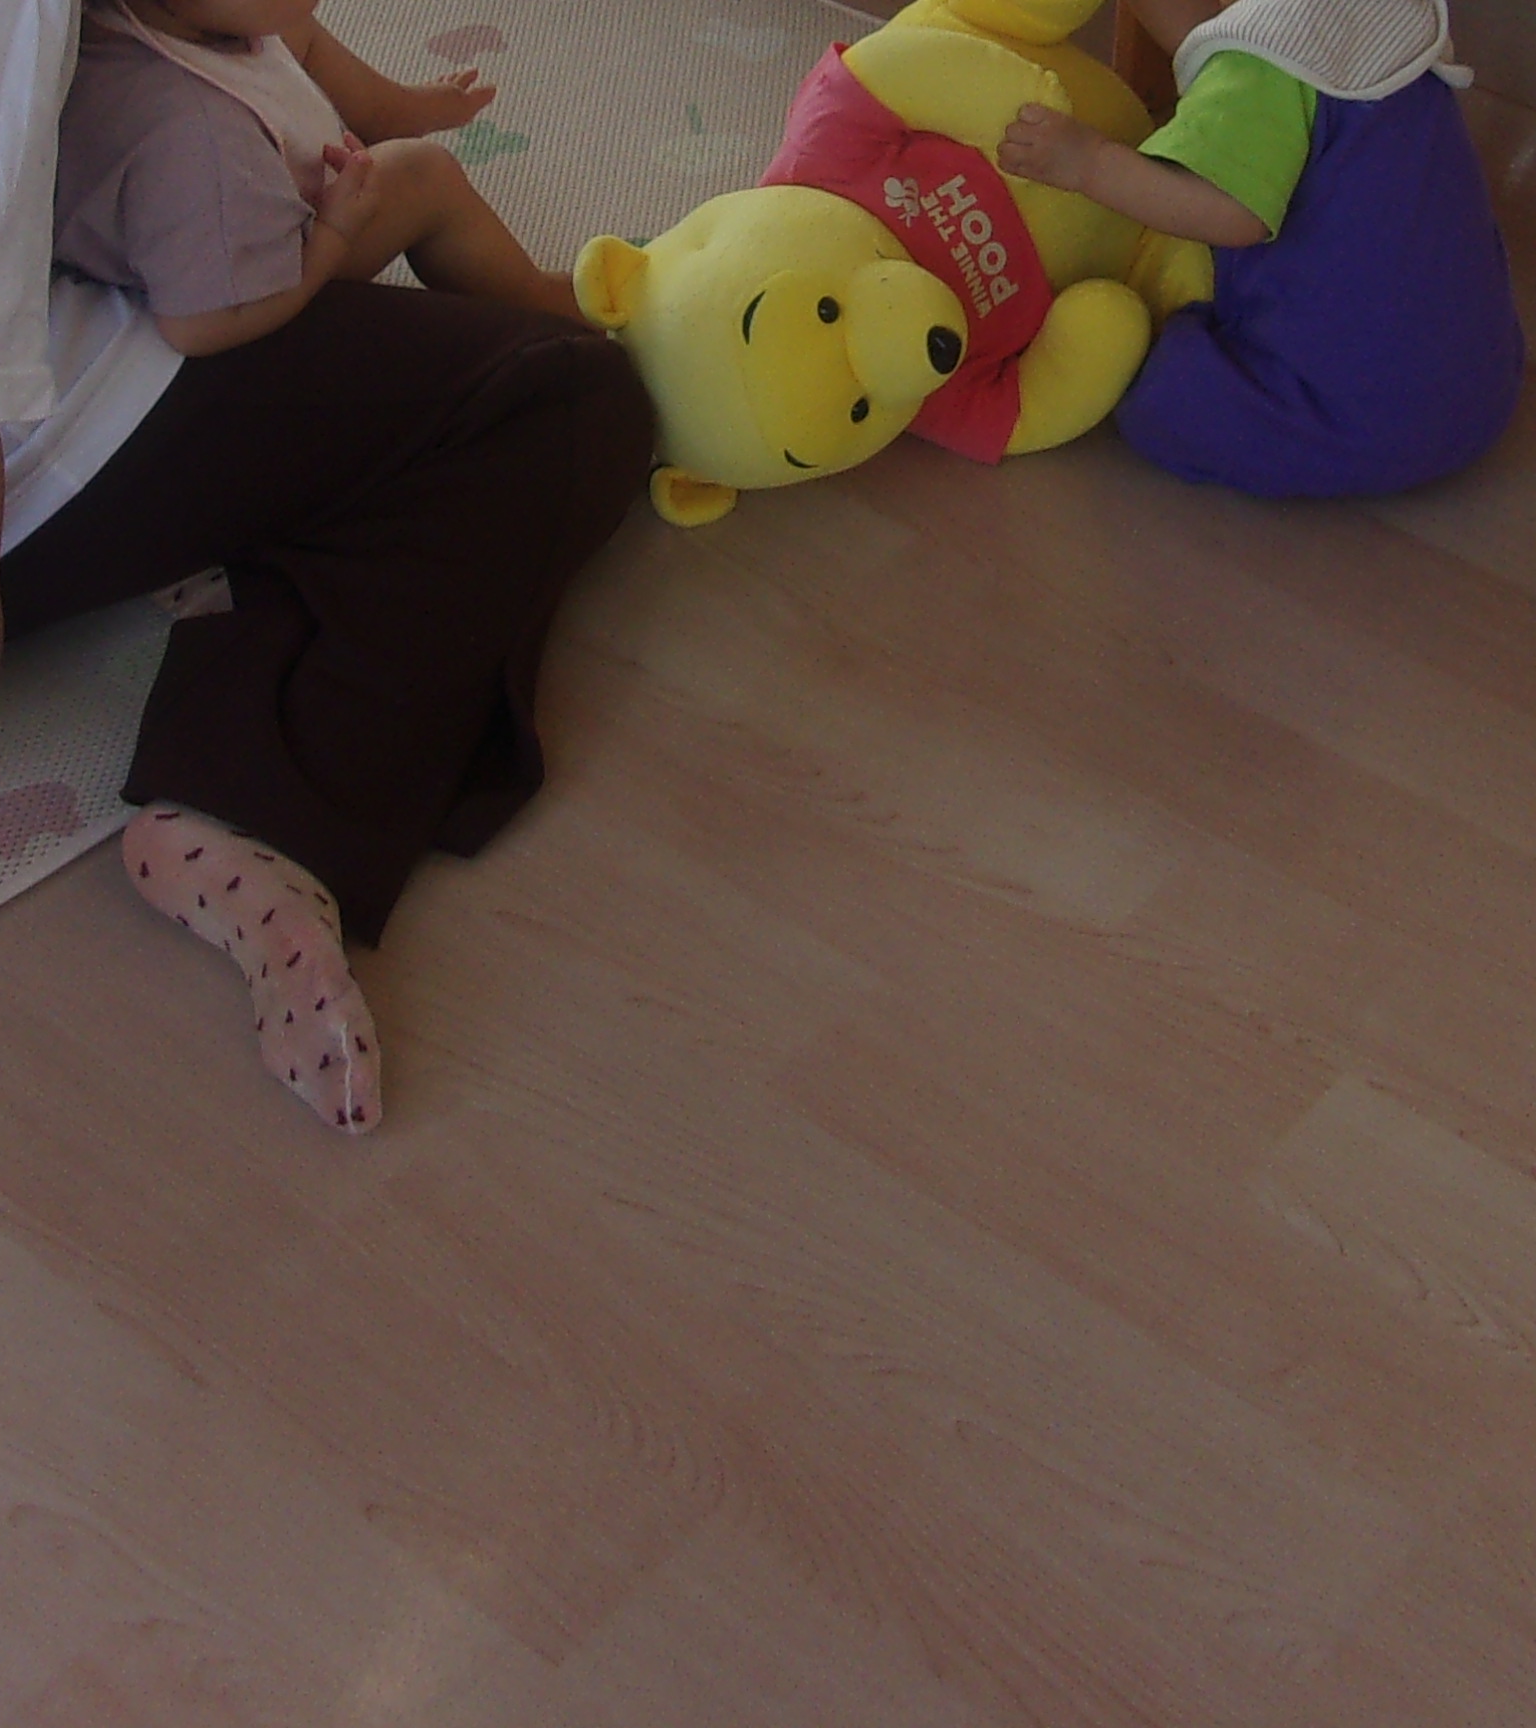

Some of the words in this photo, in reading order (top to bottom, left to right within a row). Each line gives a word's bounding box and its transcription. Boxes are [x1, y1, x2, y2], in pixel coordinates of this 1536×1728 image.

[920, 192, 957, 243] THE
[936, 174, 1020, 307] POOH
[950, 242, 993, 319] WINNIE
